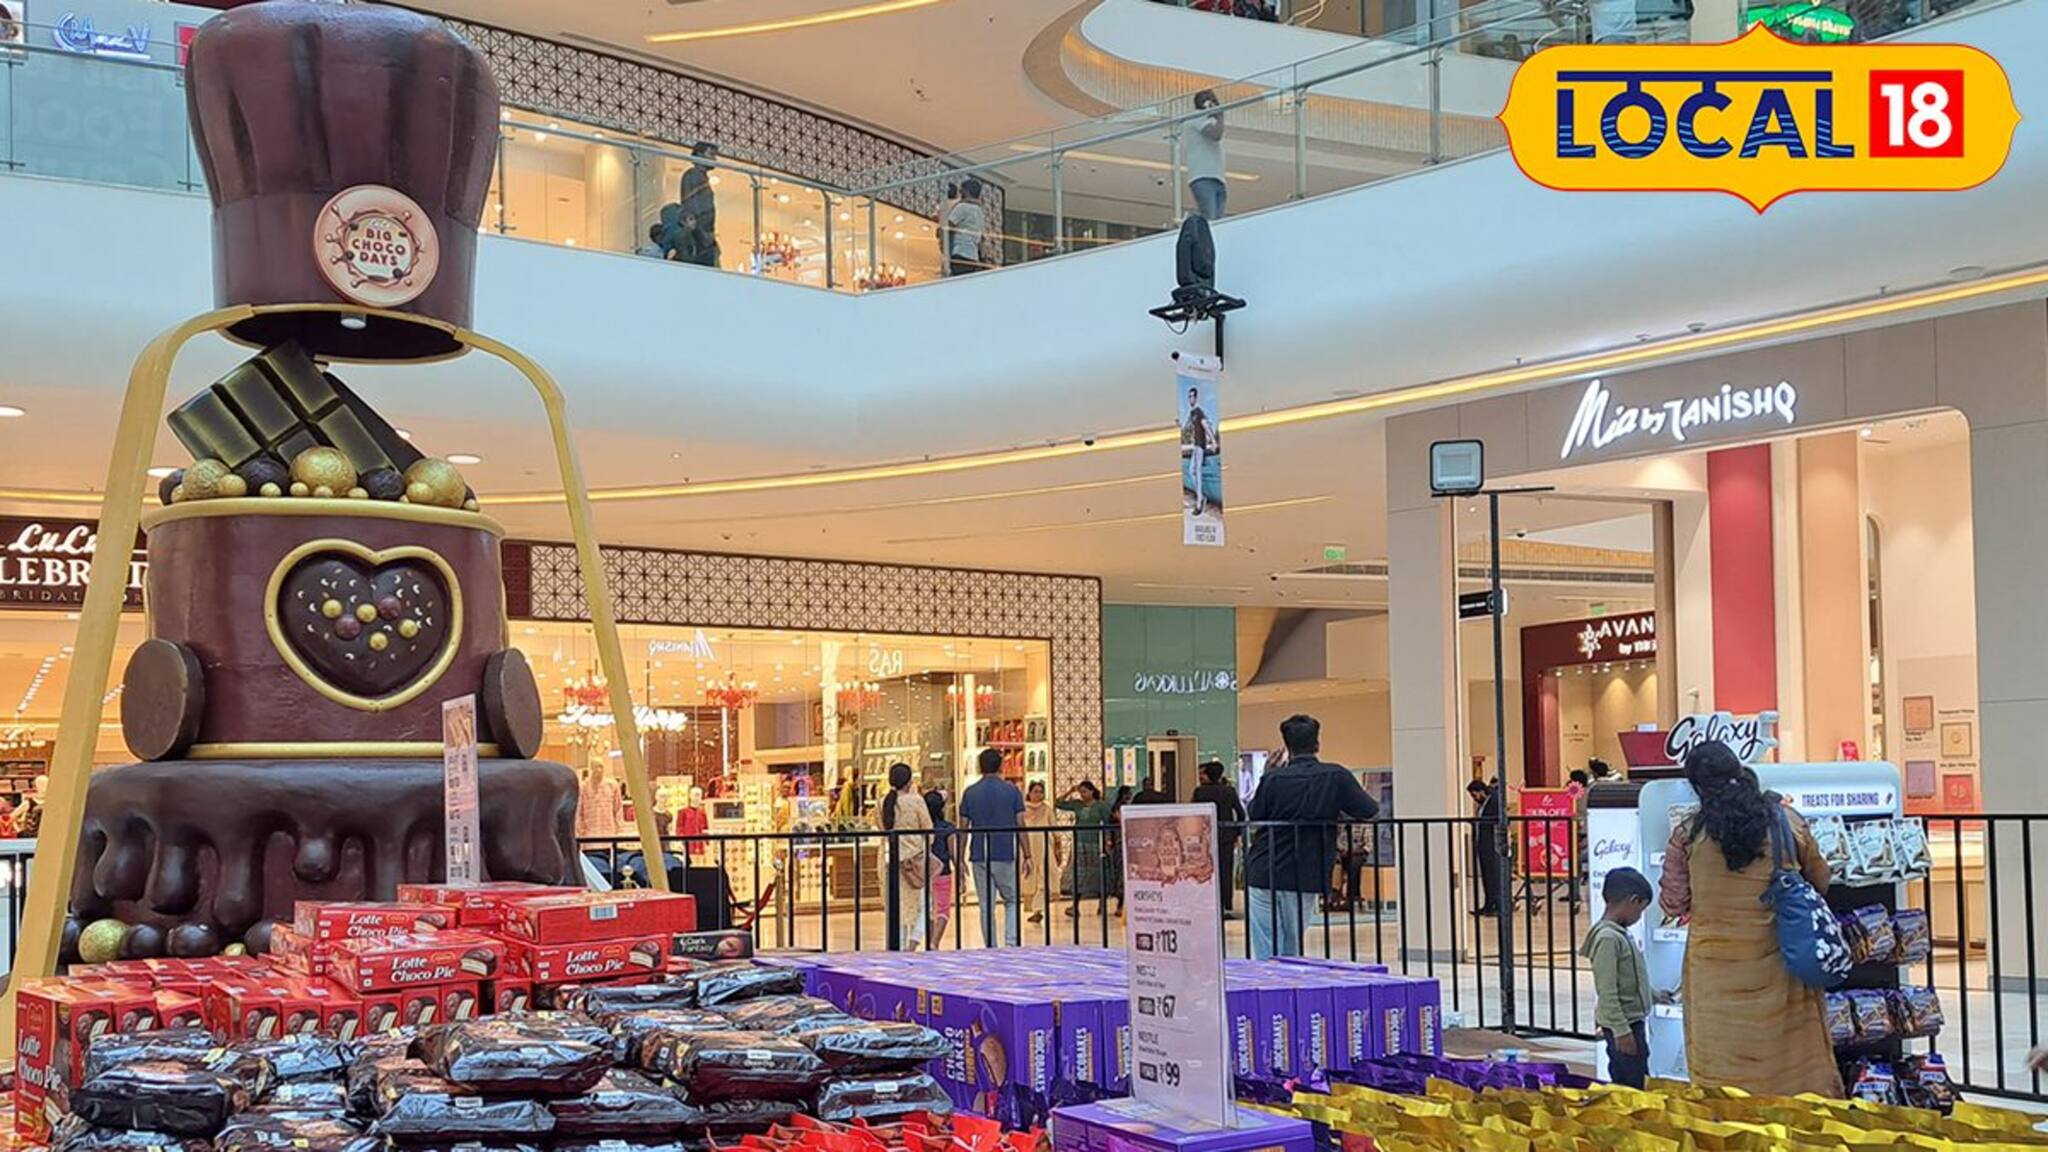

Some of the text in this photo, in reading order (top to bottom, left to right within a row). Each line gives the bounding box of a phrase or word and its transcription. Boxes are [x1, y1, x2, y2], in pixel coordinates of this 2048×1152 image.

[366, 228, 392, 241] BIG
[352, 238, 405, 256] CHOCO
[360, 251, 398, 266] DAYS
[1561, 379, 1637, 458] Mia
[1664, 381, 1797, 441] TANISHQ
[1600, 615, 1655, 639] AVAN
[1666, 714, 1763, 762] Galaxy
[1802, 793, 1829, 807] TREATS
[1846, 792, 1879, 806] SHARING
[348, 913, 384, 925] Lotte
[347, 926, 386, 939] Choco
[391, 957, 428, 970] Lotte
[567, 950, 599, 963] Lotte
[391, 966, 456, 983] Choco Pie
[566, 959, 625, 976] Choco Pie
